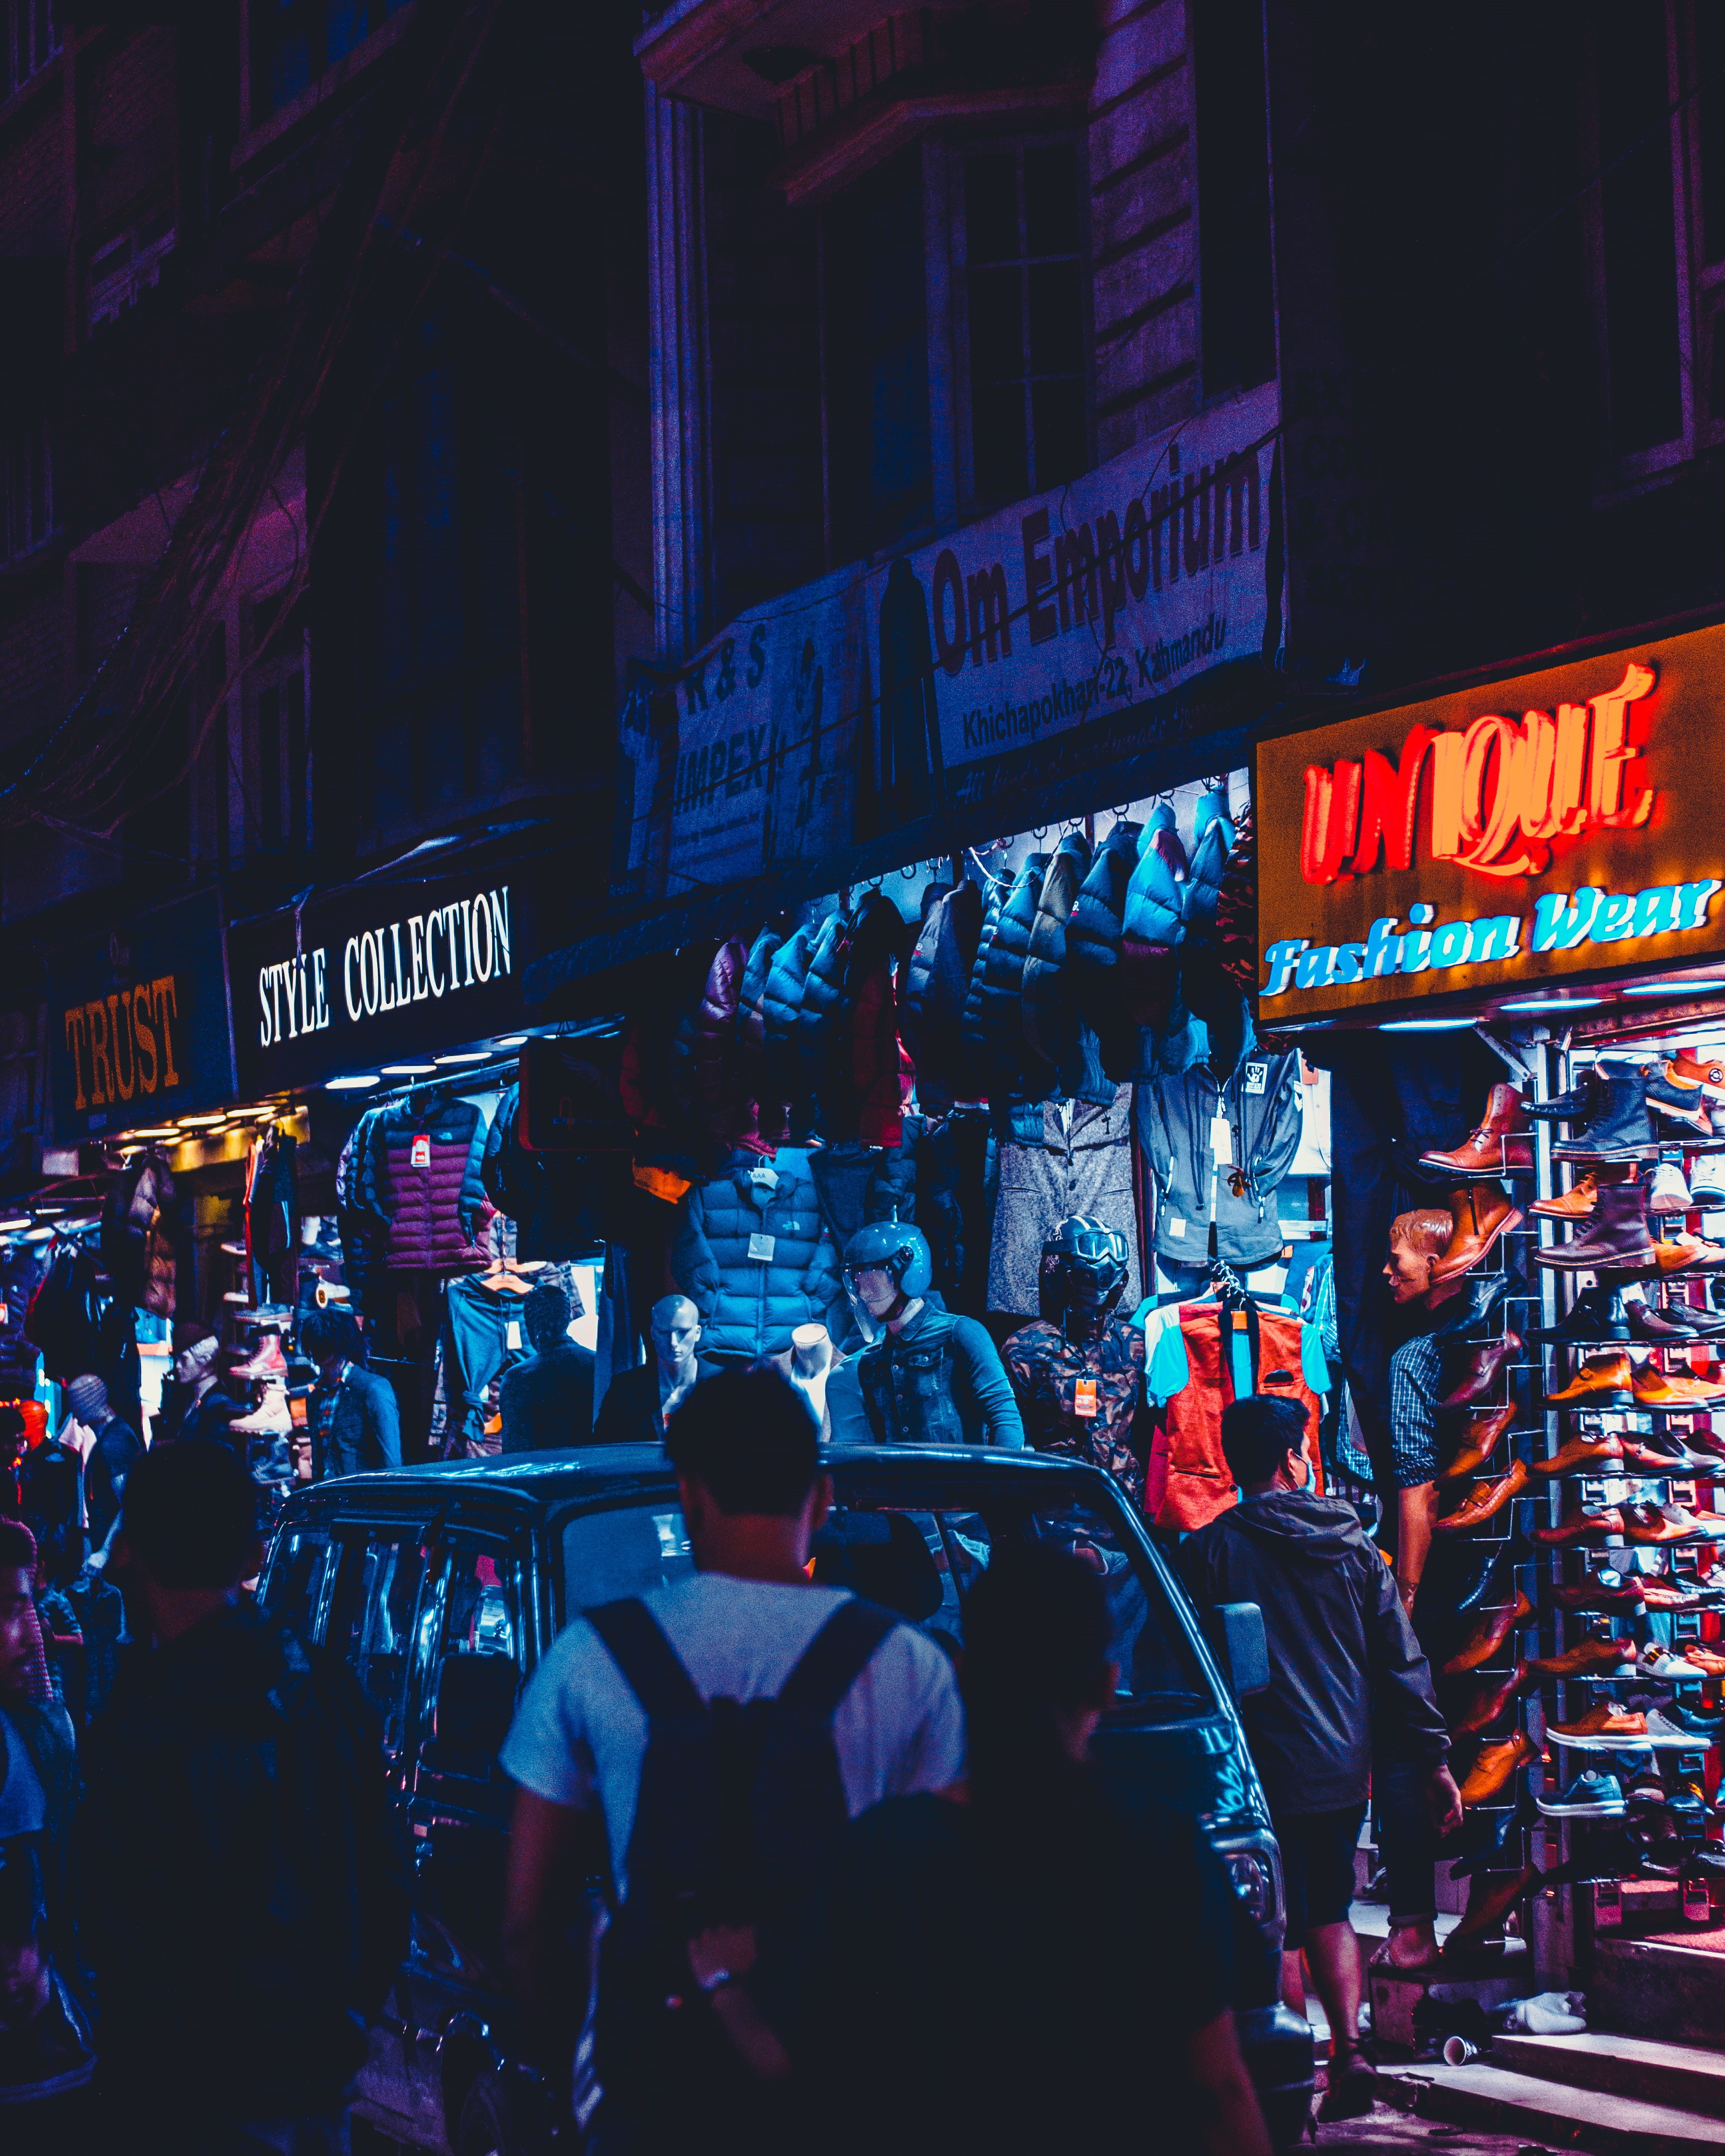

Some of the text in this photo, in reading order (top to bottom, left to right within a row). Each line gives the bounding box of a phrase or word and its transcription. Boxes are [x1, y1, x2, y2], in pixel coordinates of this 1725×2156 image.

[932, 548, 1013, 678] Om
[1022, 444, 1261, 650] Emporium
[717, 637, 736, 702] &
[747, 623, 766, 689] S
[1136, 612, 1226, 690] Kathmandu
[674, 723, 767, 814] IMPEX
[1301, 663, 1656, 885] UNIQUE
[260, 885, 511, 1048] STYLE COLLECTION
[1259, 879, 1723, 997] Fashion Wear
[65, 975, 179, 1110] TRUST
